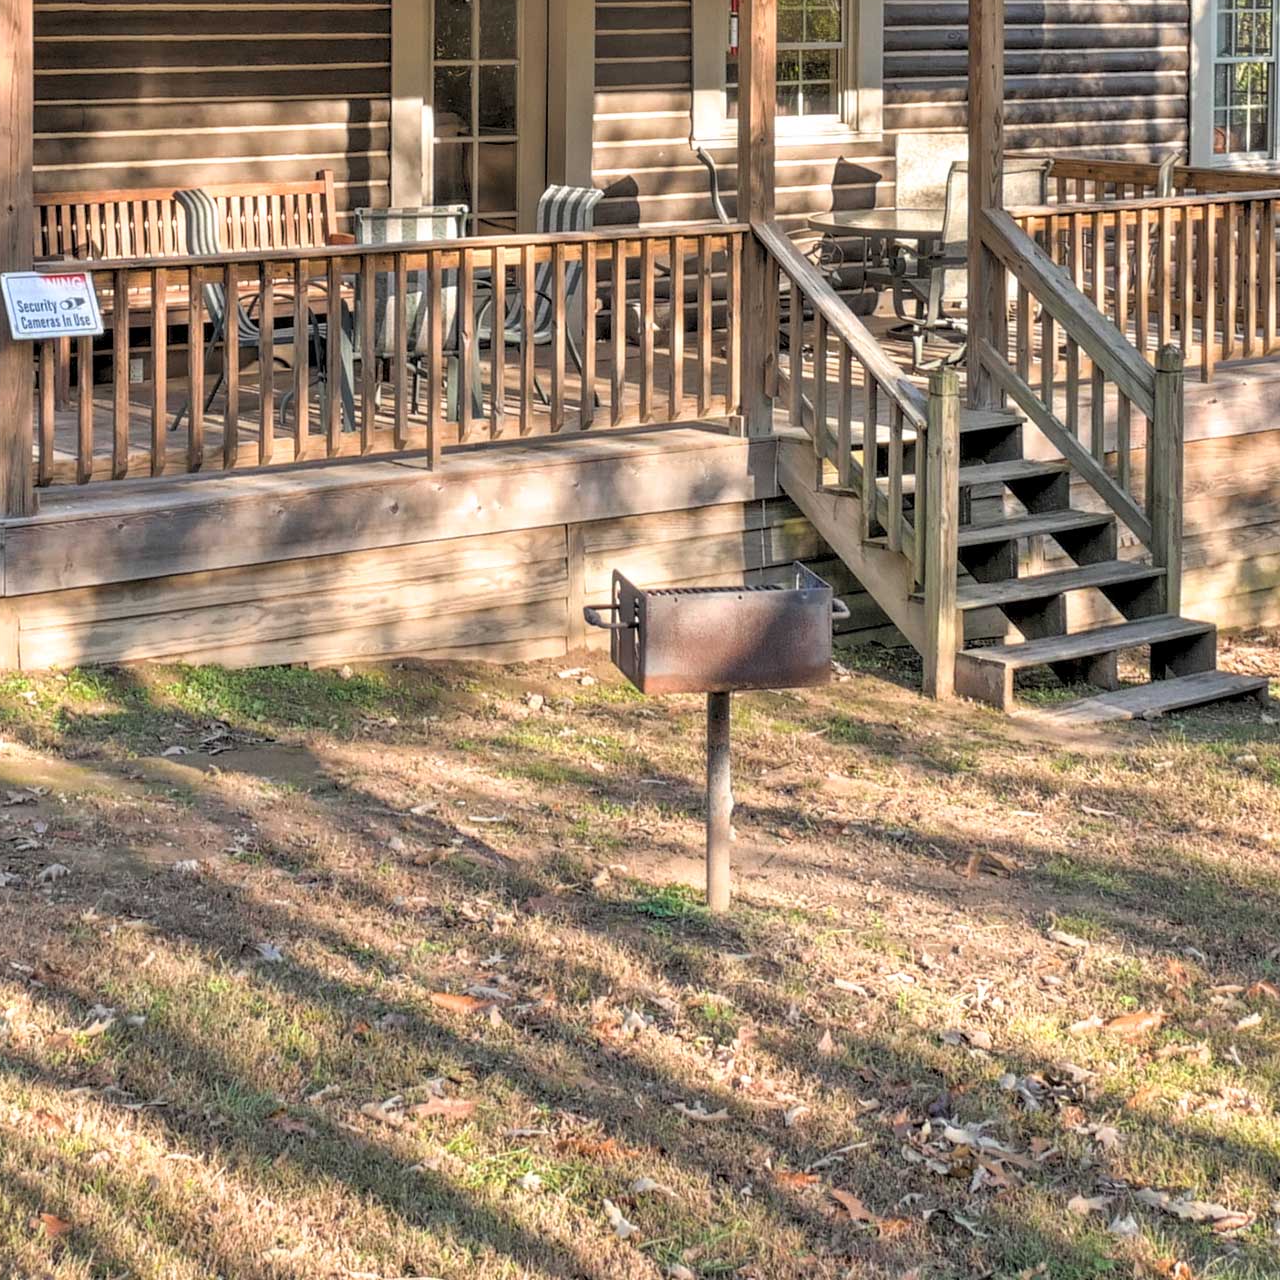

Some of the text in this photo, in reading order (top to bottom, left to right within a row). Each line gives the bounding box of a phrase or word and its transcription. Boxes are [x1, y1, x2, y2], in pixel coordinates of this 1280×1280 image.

[16, 299, 57, 314] Security
[21, 314, 91, 329] Cameras In Use
